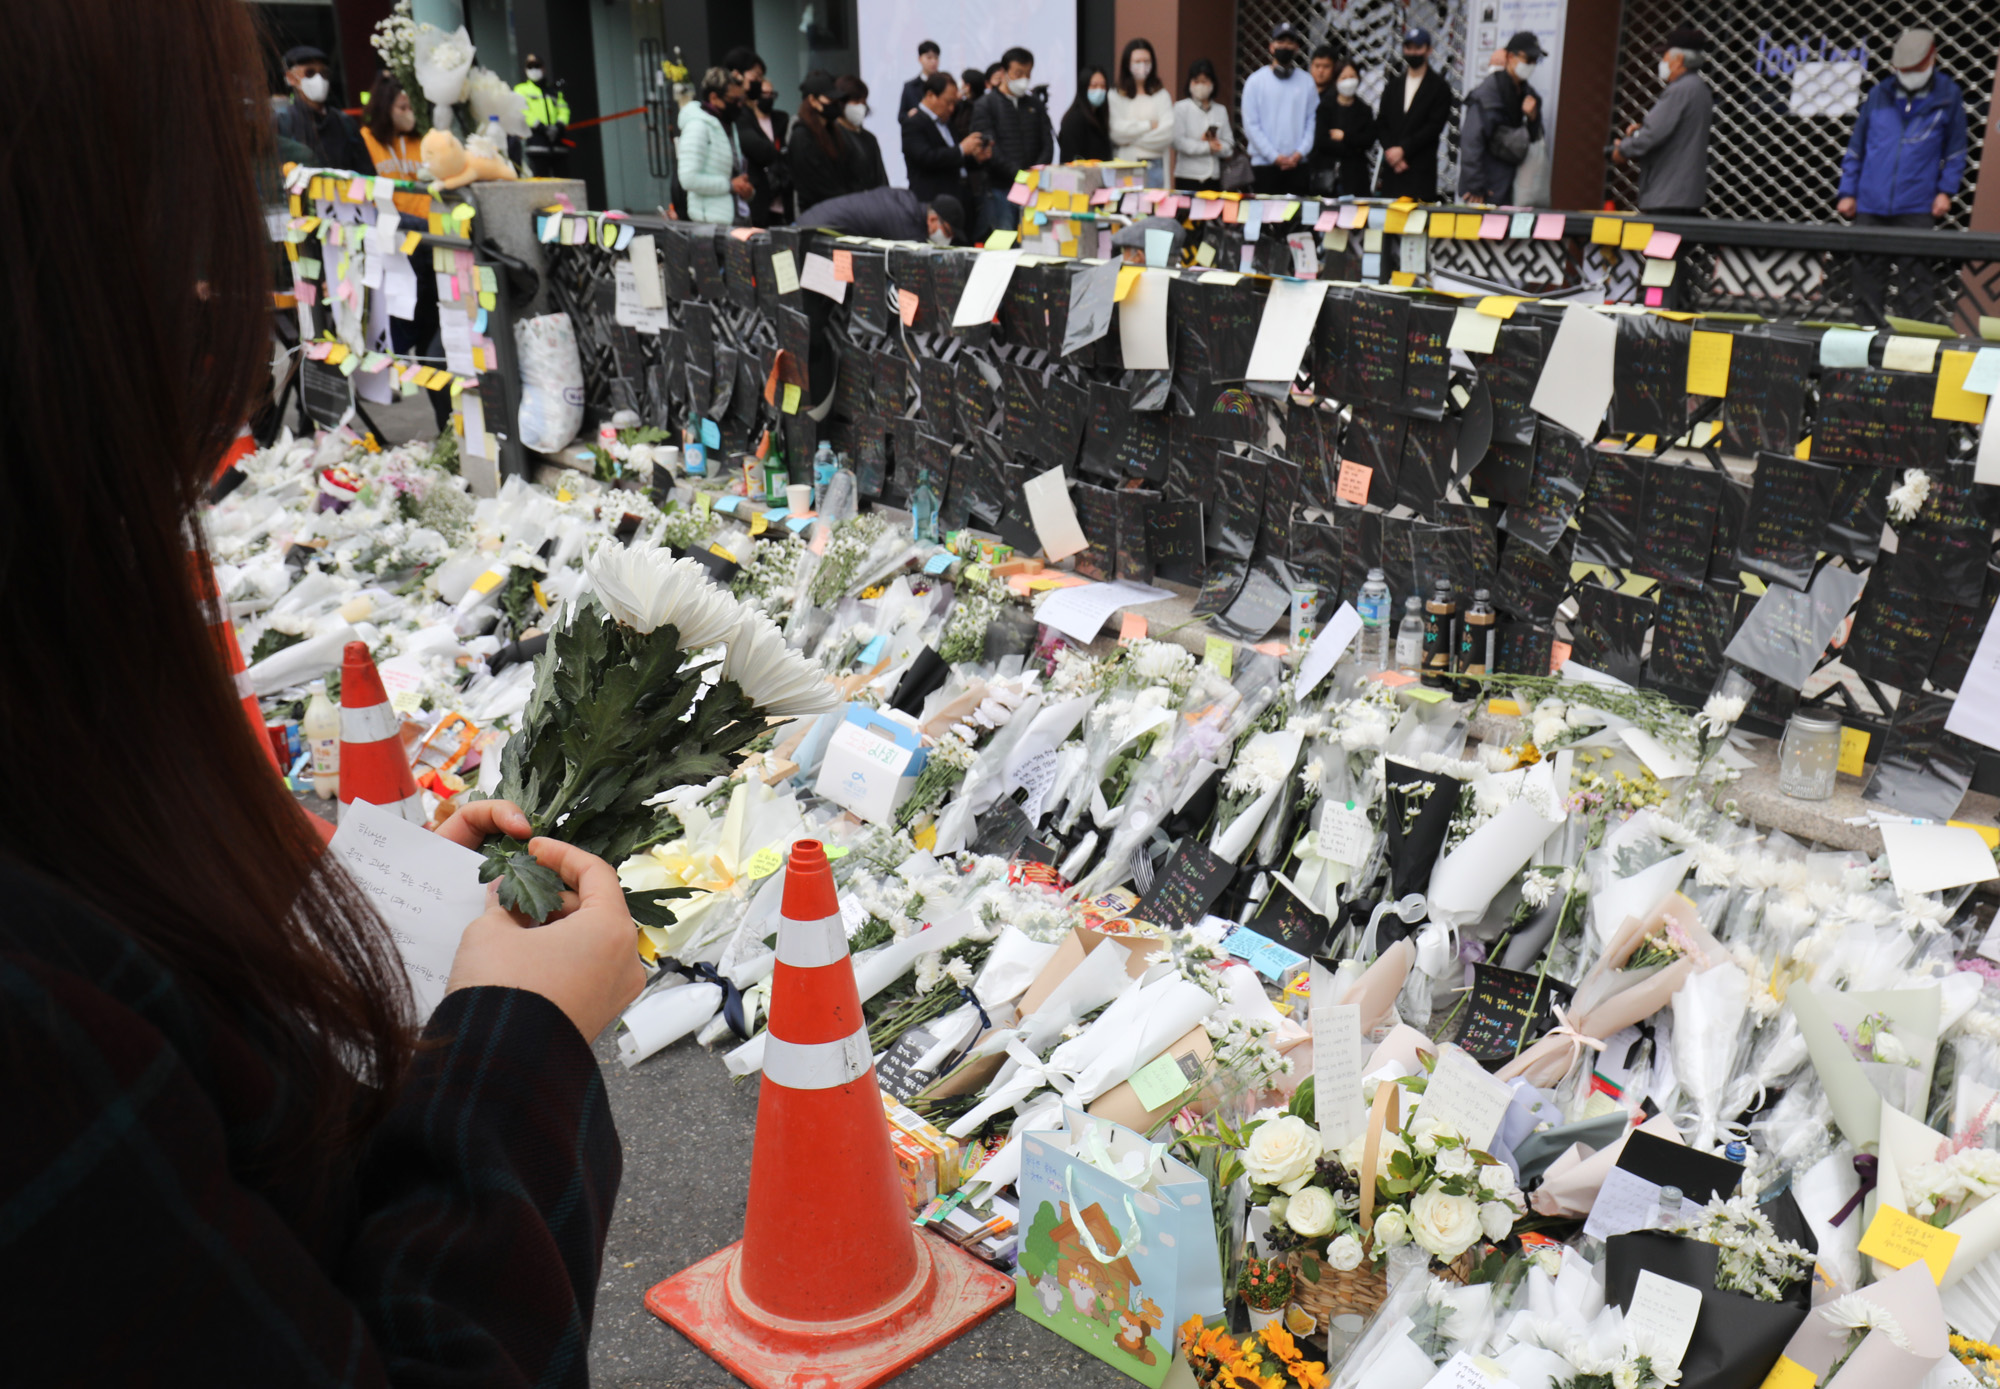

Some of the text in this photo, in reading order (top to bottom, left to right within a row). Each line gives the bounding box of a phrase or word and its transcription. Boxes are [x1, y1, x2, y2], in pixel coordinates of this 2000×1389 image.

[1150, 535, 1194, 557] Peace
[358, 823, 388, 847] 하나님은
[345, 848, 363, 863] 온갖
[368, 858, 391, 875] 고난을
[419, 881, 446, 901] 우리를
[1473, 1009, 1502, 1029] 하늘에서
[1467, 1024, 1492, 1040] 못다한
[967, 1138, 981, 1170] Peaches
